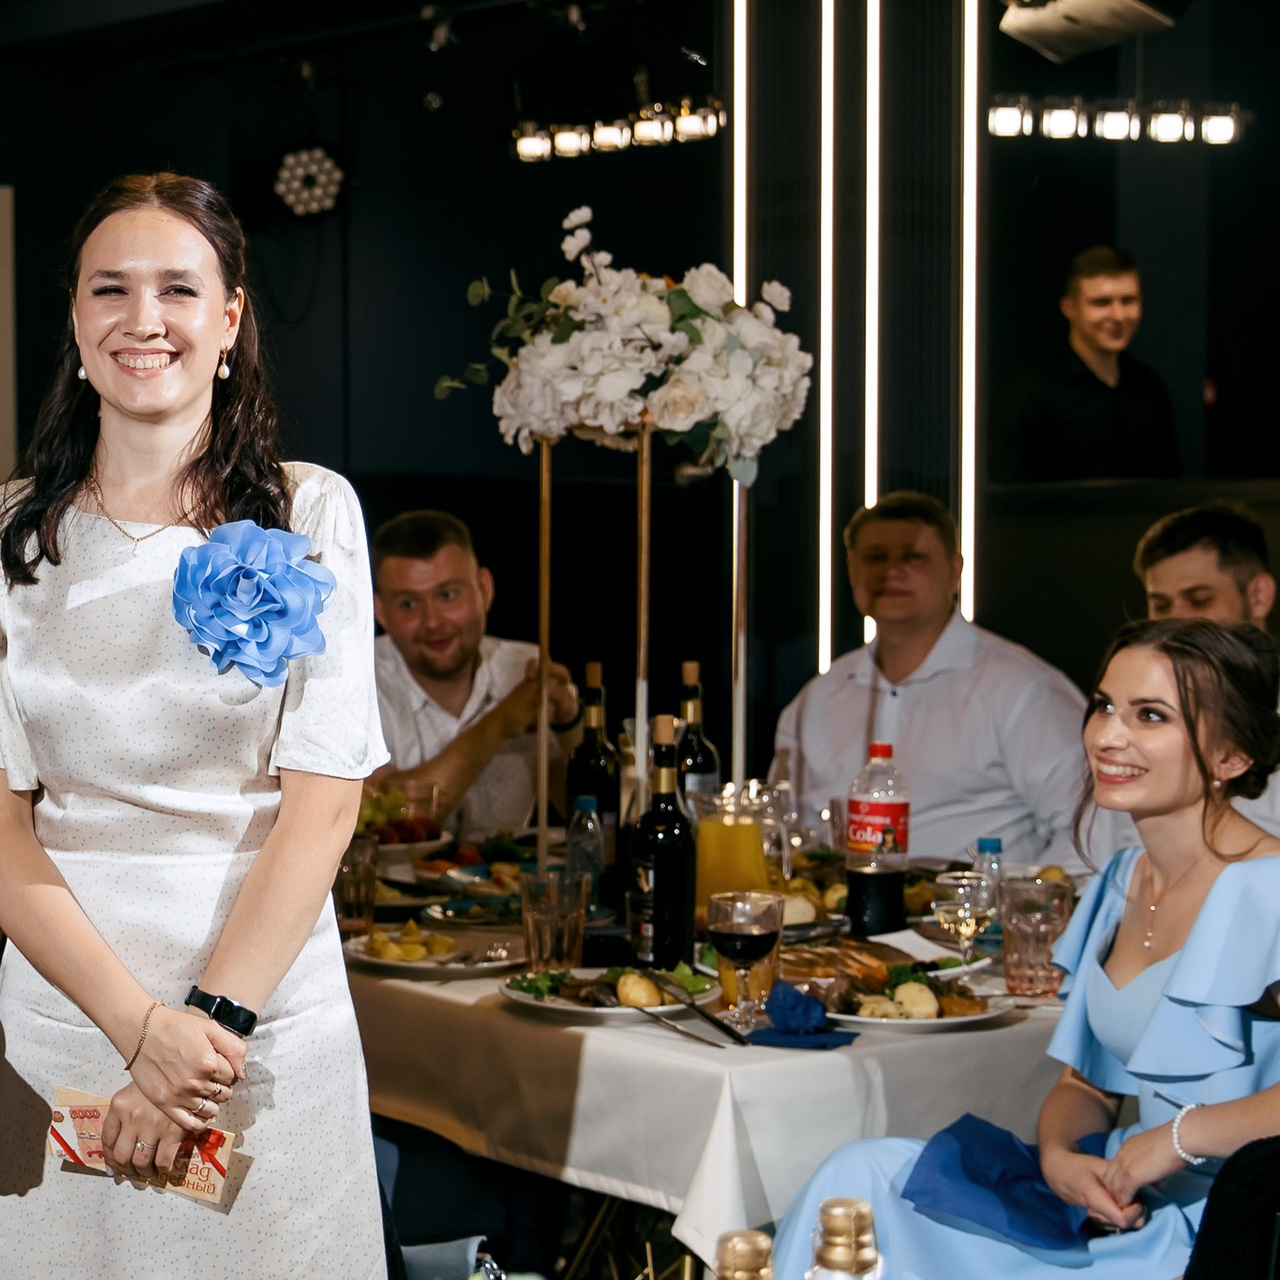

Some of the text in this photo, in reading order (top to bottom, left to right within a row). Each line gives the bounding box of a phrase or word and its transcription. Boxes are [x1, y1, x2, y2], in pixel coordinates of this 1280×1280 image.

[848, 824, 883, 845] Cola
[70, 1109, 101, 1120] 5000
[159, 1172, 216, 1195] дебный
